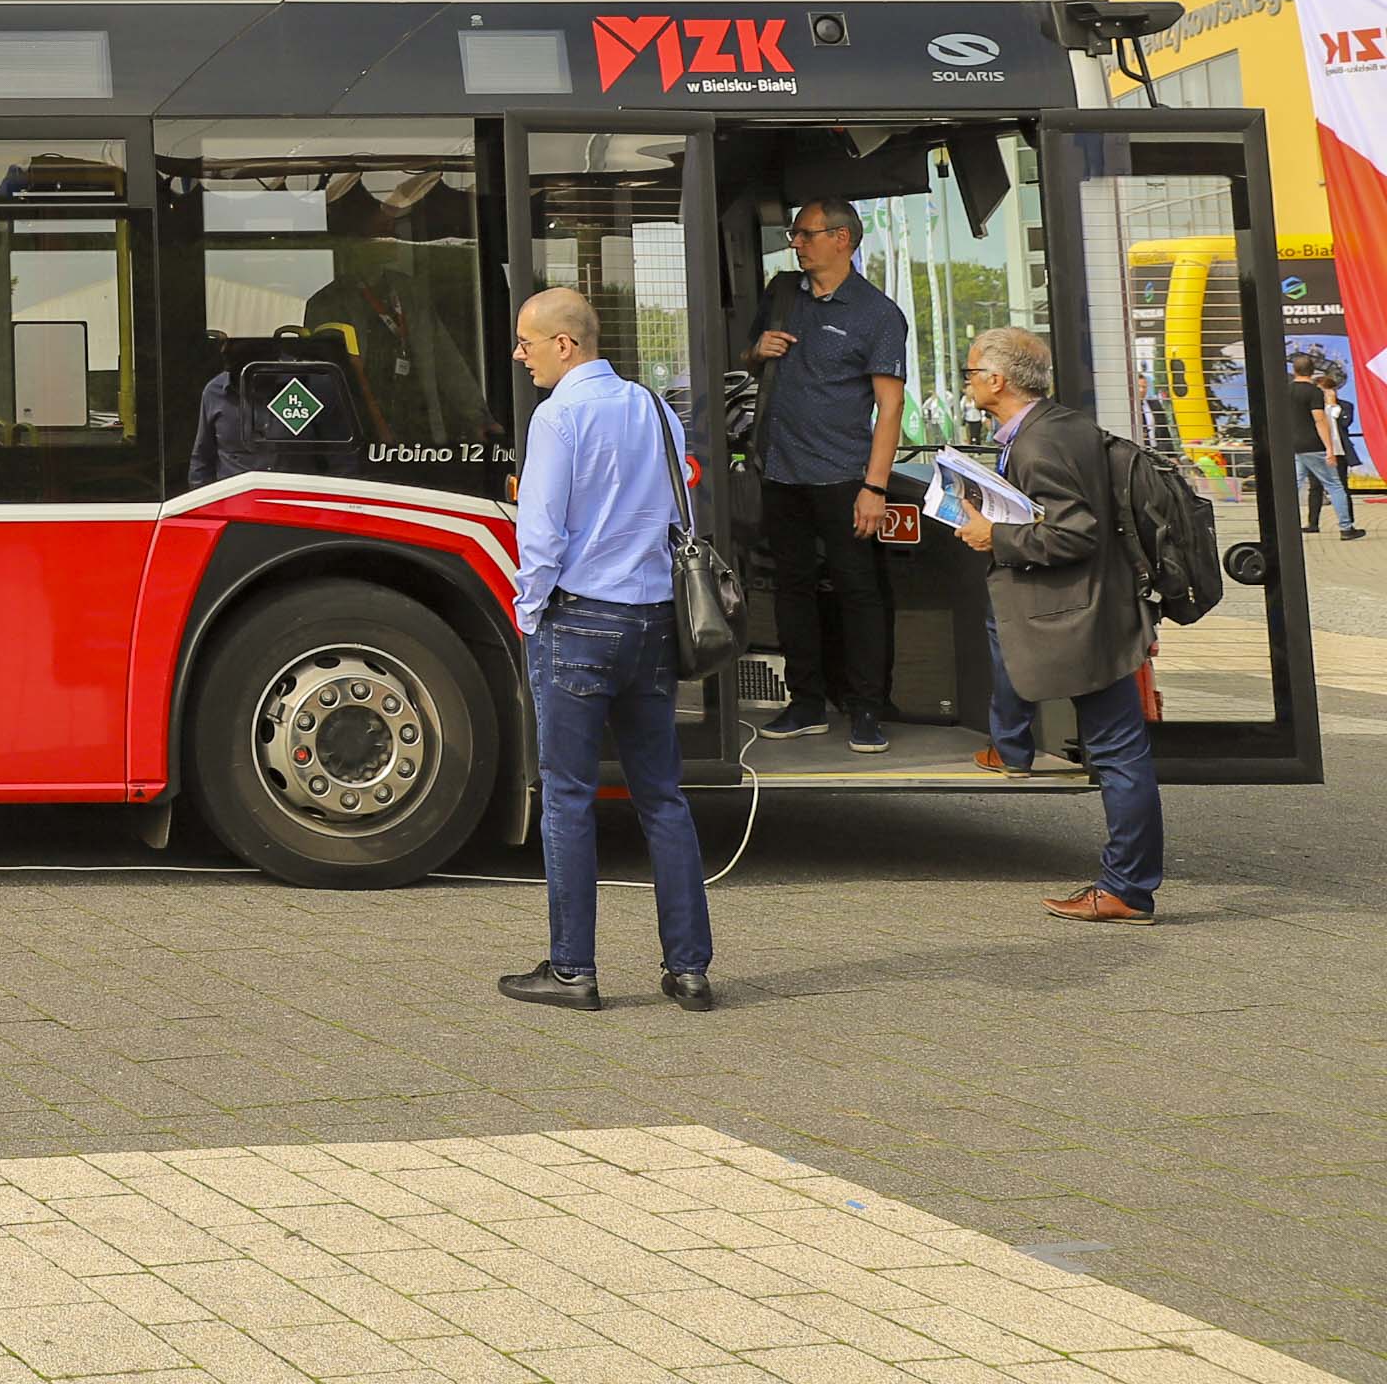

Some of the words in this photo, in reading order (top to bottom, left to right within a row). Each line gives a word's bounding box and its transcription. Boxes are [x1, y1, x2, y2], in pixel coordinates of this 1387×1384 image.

[592, 16, 795, 94] MZK
[932, 71, 1005, 82] SOLARIS
[687, 83, 700, 93] w
[702, 78, 797, 94] Bielsku-Białej
[282, 407, 310, 419] GAS
[368, 443, 453, 462] Urbino
[460, 443, 484, 462] 12
